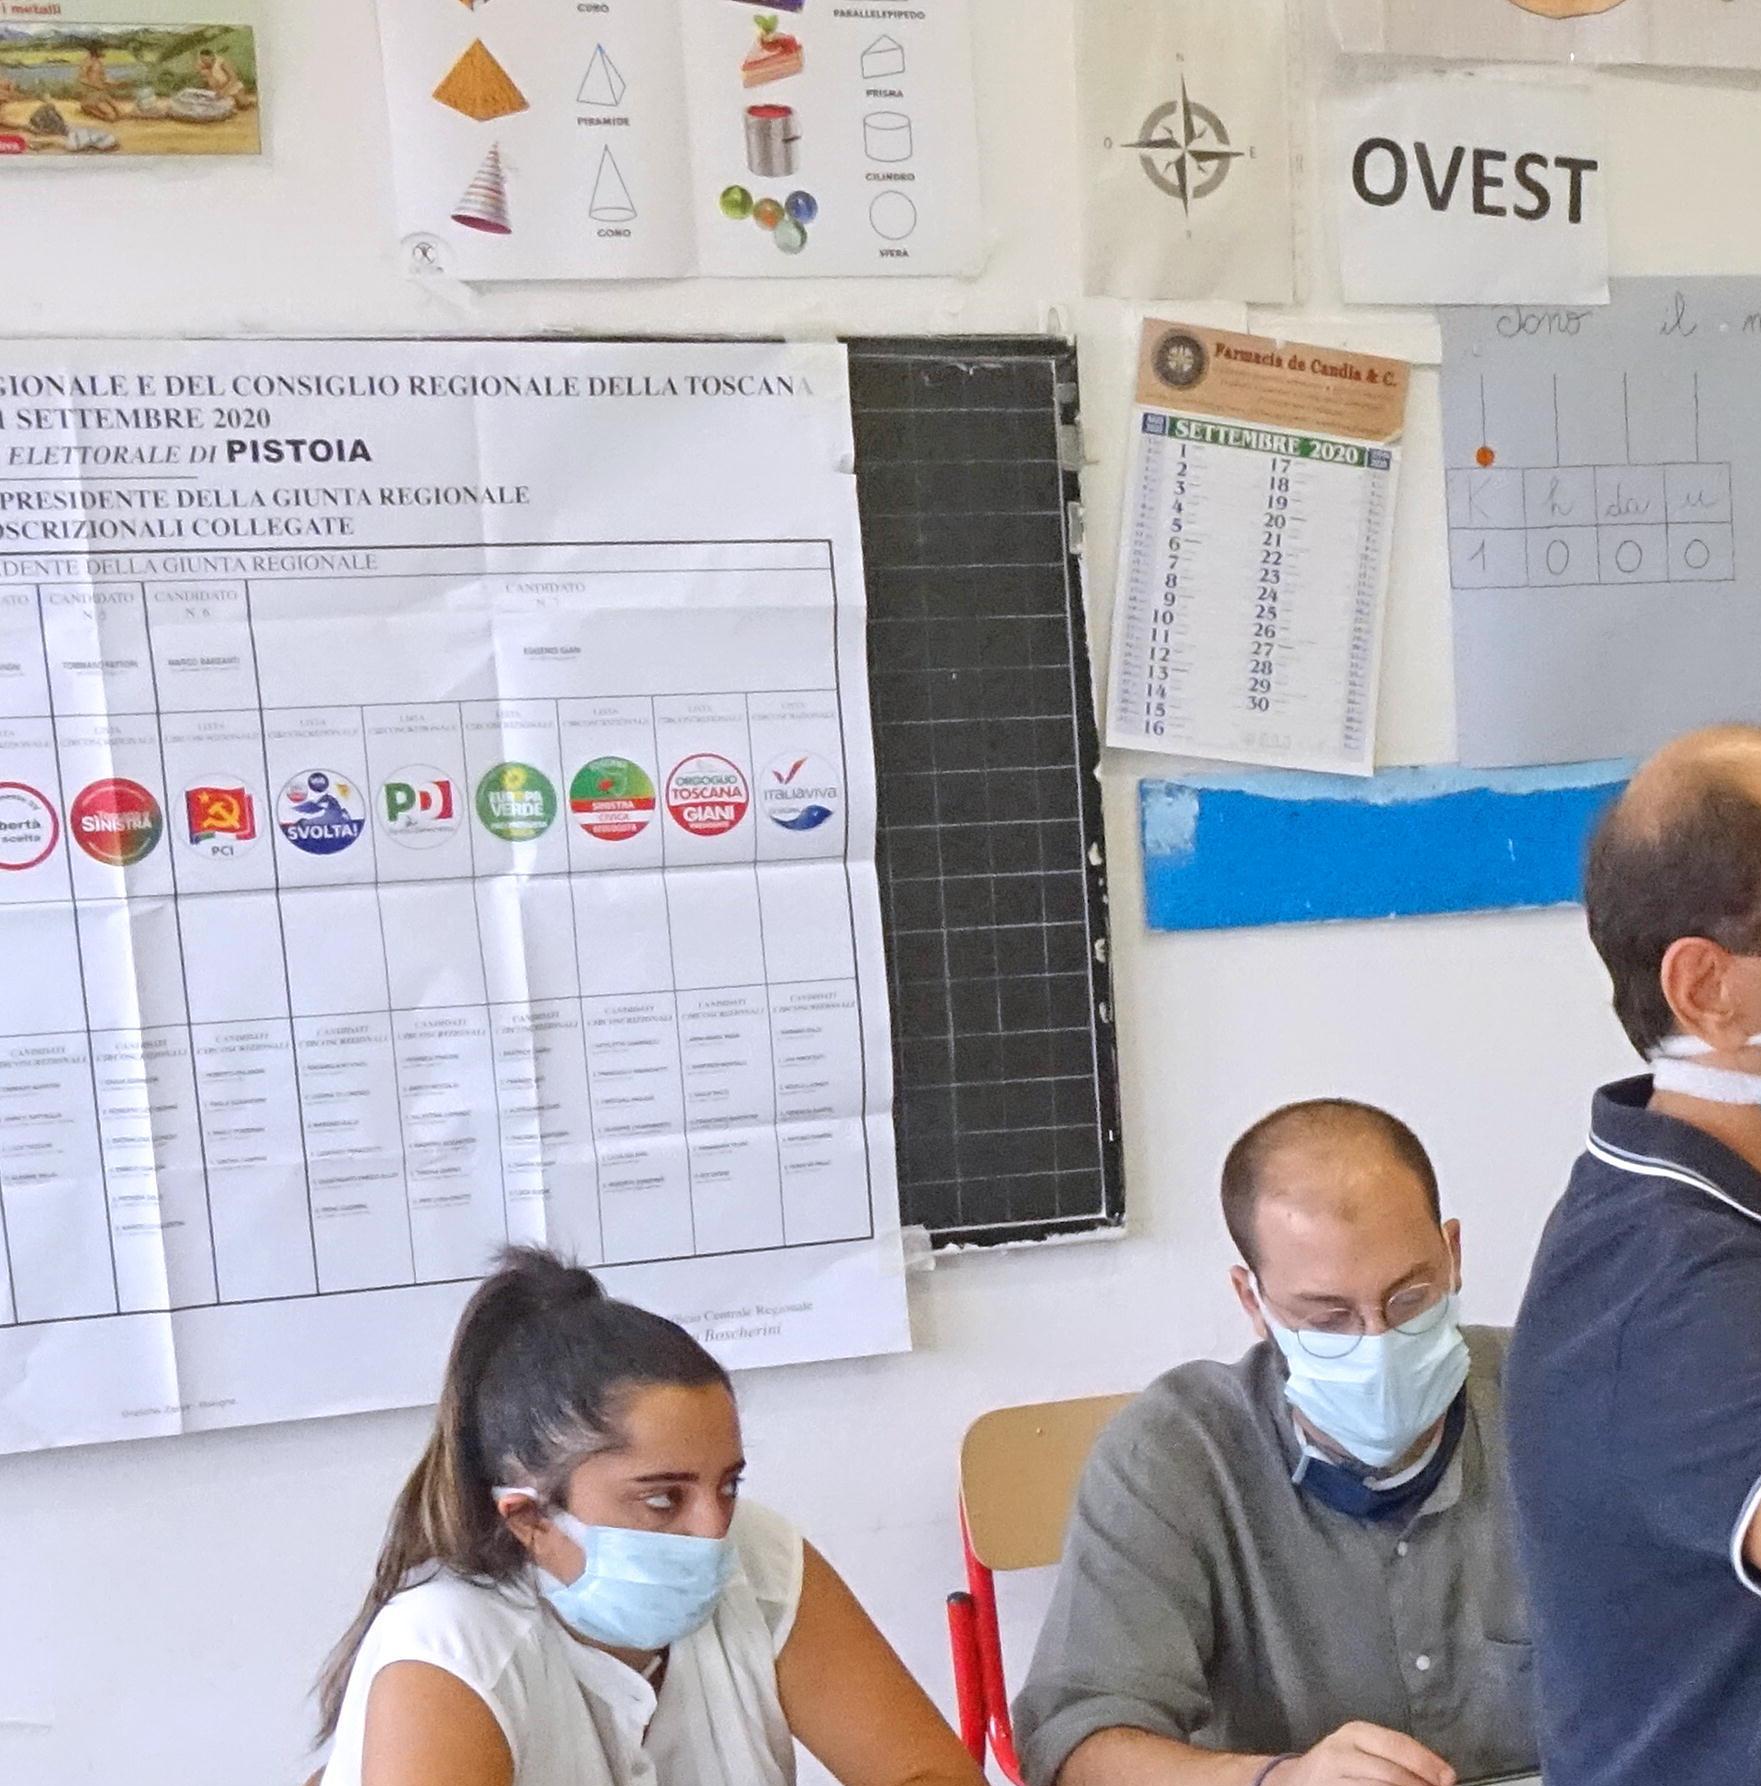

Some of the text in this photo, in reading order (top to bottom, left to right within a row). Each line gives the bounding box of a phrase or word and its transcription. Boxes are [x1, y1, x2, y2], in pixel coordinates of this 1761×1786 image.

[577, 116, 631, 127] PIRAMIDE
[1351, 136, 1599, 224] OVEST
[596, 228, 631, 238] CONO
[1660, 292, 1698, 337] il
[1214, 342, 1283, 370] Farmacia
[1287, 354, 1306, 371] de
[138, 376, 155, 396] E
[165, 375, 225, 396] DEL
[232, 374, 399, 397] CONSIGLIO
[409, 375, 580, 397] REGIONALE
[588, 374, 678, 397] DELLA
[684, 374, 814, 397] TOSCANA
[16, 407, 271, 430] SETTEMBRE 2020
[1174, 417, 1301, 457] SETTEMBRE
[1309, 439, 1359, 464] 2020
[8, 438, 373, 466] ELETTORALE DI PISTOIA
[1178, 462, 1187, 477] 2
[1271, 458, 1291, 473] 17
[1175, 481, 1185, 495] 3
[1270, 477, 1289, 493] 18
[177, 488, 266, 510] DELLA
[273, 488, 372, 508] GIUNTA
[380, 485, 530, 507] REGIONALE
[1268, 496, 1288, 510] 19
[1464, 478, 1495, 522] K
[1173, 499, 1183, 514] 4
[192, 516, 355, 539] COLLEGATE
[1172, 518, 1182, 532] 5
[1264, 513, 1286, 528] 20
[1169, 536, 1180, 551] 6
[1263, 532, 1281, 547] 21
[1168, 555, 1178, 569] 7
[1261, 551, 1282, 565] 22
[1468, 537, 1710, 575] 1 0 0 0
[87, 558, 156, 576] DELLA
[163, 556, 246, 574] GIUNTA
[252, 554, 378, 573] REGIONALE
[1165, 574, 1176, 588] 8
[1259, 569, 1280, 583] 23
[1164, 592, 1175, 606] 9
[1258, 587, 1278, 602] 24
[1153, 609, 1173, 624] 10
[1256, 606, 1276, 621] 25
[1152, 628, 1169, 642] 11
[1254, 623, 1275, 639] 26
[1150, 647, 1170, 662] 12
[1252, 642, 1274, 657] 27
[1149, 666, 1169, 680] 13
[1251, 660, 1273, 675] 28
[1147, 685, 1167, 699] 14
[1249, 678, 1271, 693] 29
[1146, 703, 1165, 717] 15
[1247, 696, 1269, 711] 30
[1145, 721, 1164, 736] 16
[675, 774, 738, 786] ORGOGLIO
[385, 779, 454, 822] PD
[670, 786, 743, 800] TOSCANA
[490, 801, 544, 818] VERDE
[682, 805, 735, 822] GIANI
[286, 823, 359, 841] SVOLTA!
[211, 845, 235, 857] PCI
[704, 1308, 751, 1321] Centrale
